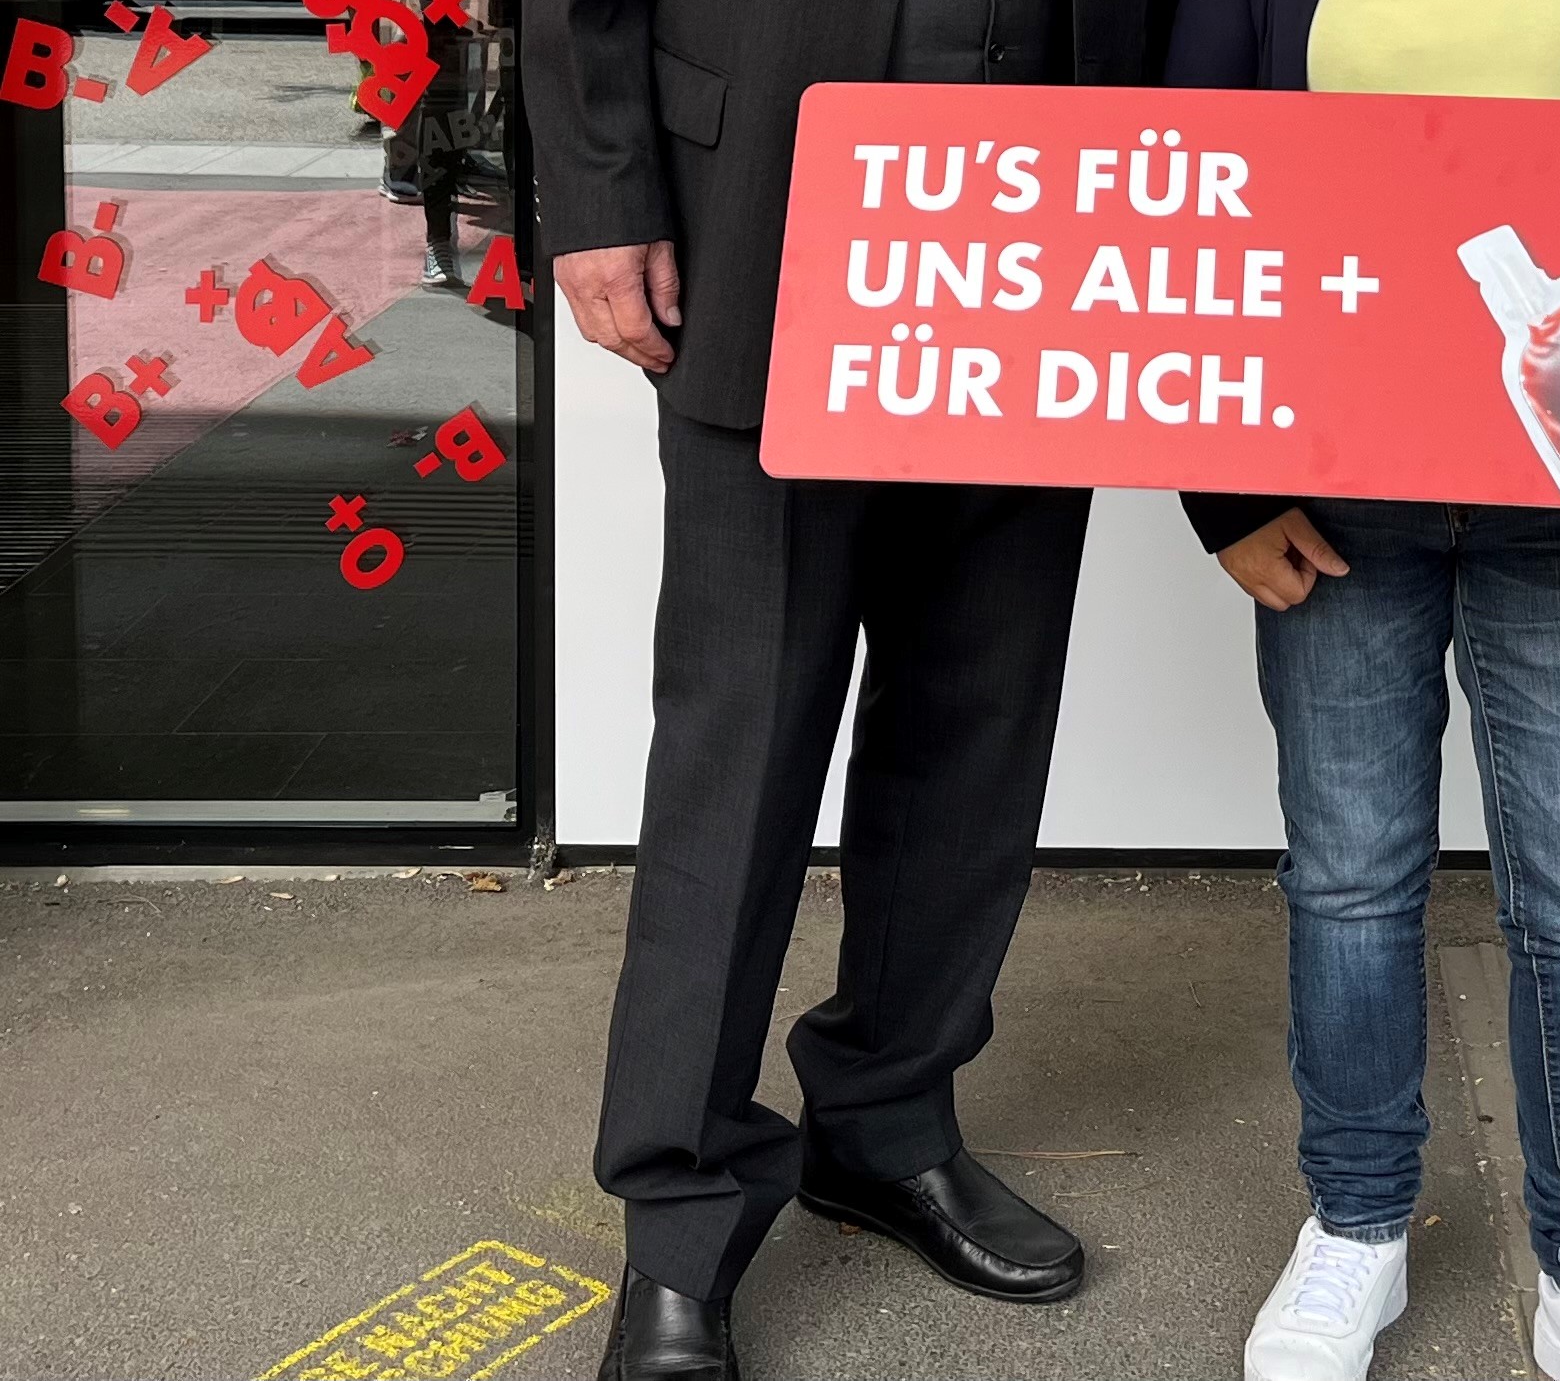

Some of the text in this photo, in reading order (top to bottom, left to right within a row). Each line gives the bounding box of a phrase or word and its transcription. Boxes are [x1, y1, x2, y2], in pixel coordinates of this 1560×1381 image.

[853, 128, 1253, 218] TU'S FÜR
[846, 239, 1043, 311] UNS
[1071, 244, 1284, 318] ALLE
[827, 323, 1295, 429] FÜR DICH.
